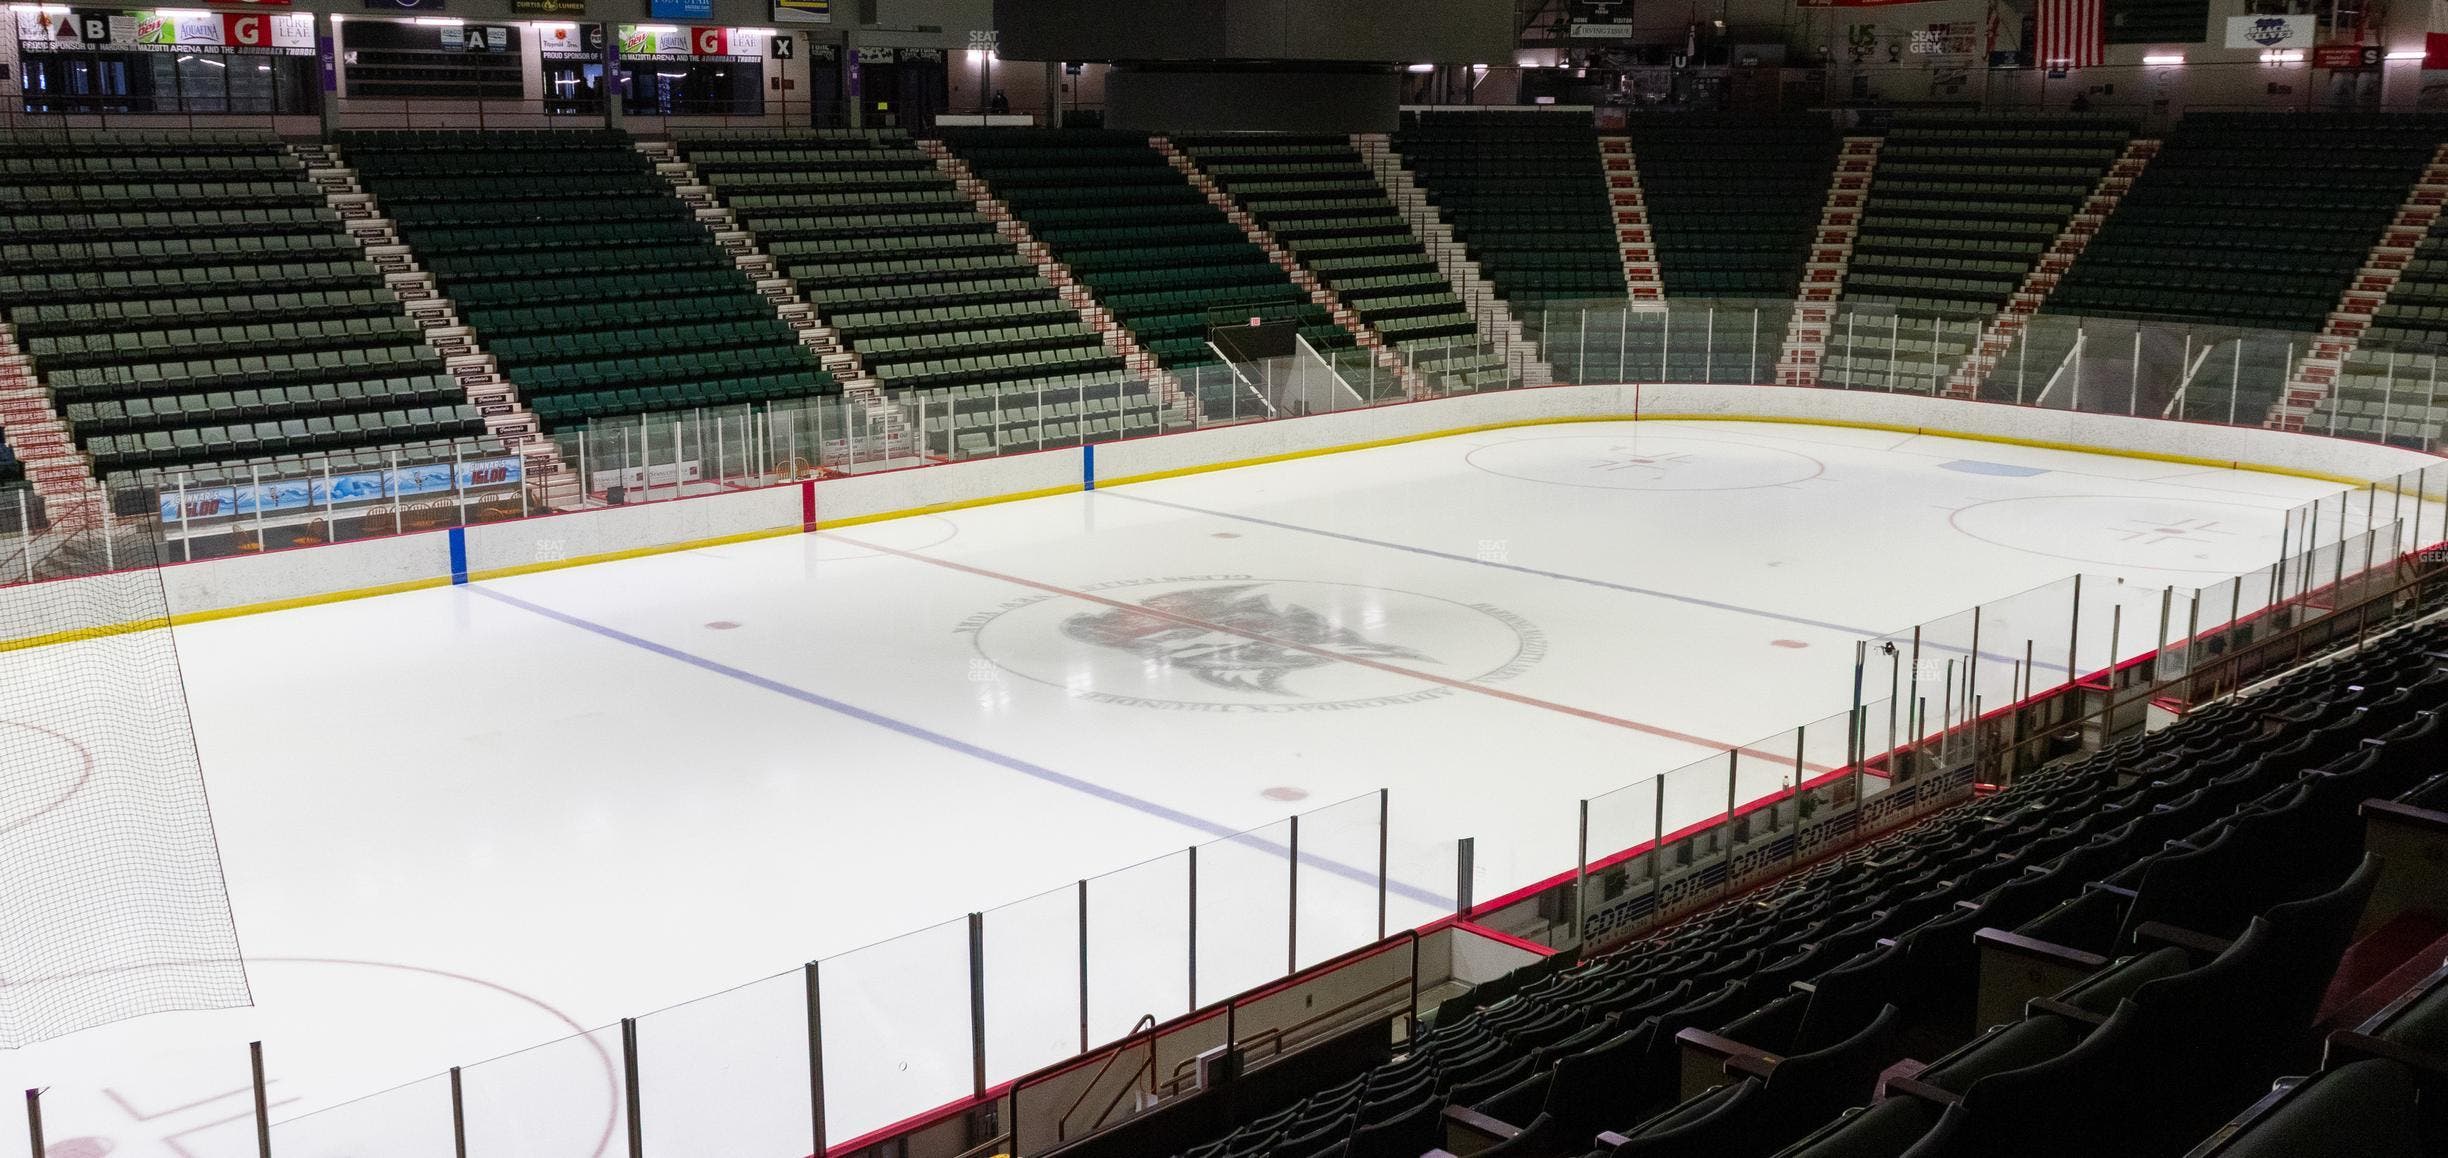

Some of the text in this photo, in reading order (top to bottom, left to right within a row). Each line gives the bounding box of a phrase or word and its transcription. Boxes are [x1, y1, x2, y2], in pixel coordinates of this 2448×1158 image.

[86, 20, 105, 39] B
[181, 23, 218, 37] AQUAFINA
[234, 16, 259, 45] G
[279, 28, 310, 38] LEAF
[2244, 31, 2293, 41] VELVET
[2250, 25, 2290, 33] BLACK
[469, 31, 486, 48] A
[659, 37, 688, 49] AQUAFINA
[699, 30, 719, 54] G
[50, 41, 86, 50] SPONSOR
[137, 44, 170, 52] MAZZOTTI
[170, 45, 202, 54] ARENA
[203, 46, 220, 54] AND
[221, 46, 235, 54] THE
[777, 39, 789, 55] X
[543, 51, 563, 59] PROUD
[591, 52, 599, 60] OF
[652, 54, 675, 62] ARENA
[737, 55, 762, 63] THUNDER
[1675, 55, 1687, 68] U
[2364, 50, 2378, 64] S
[472, 467, 507, 485] IGLOO
[1248, 687, 1455, 713] ADIRONDACK
[1584, 903, 1630, 941] CDTA
